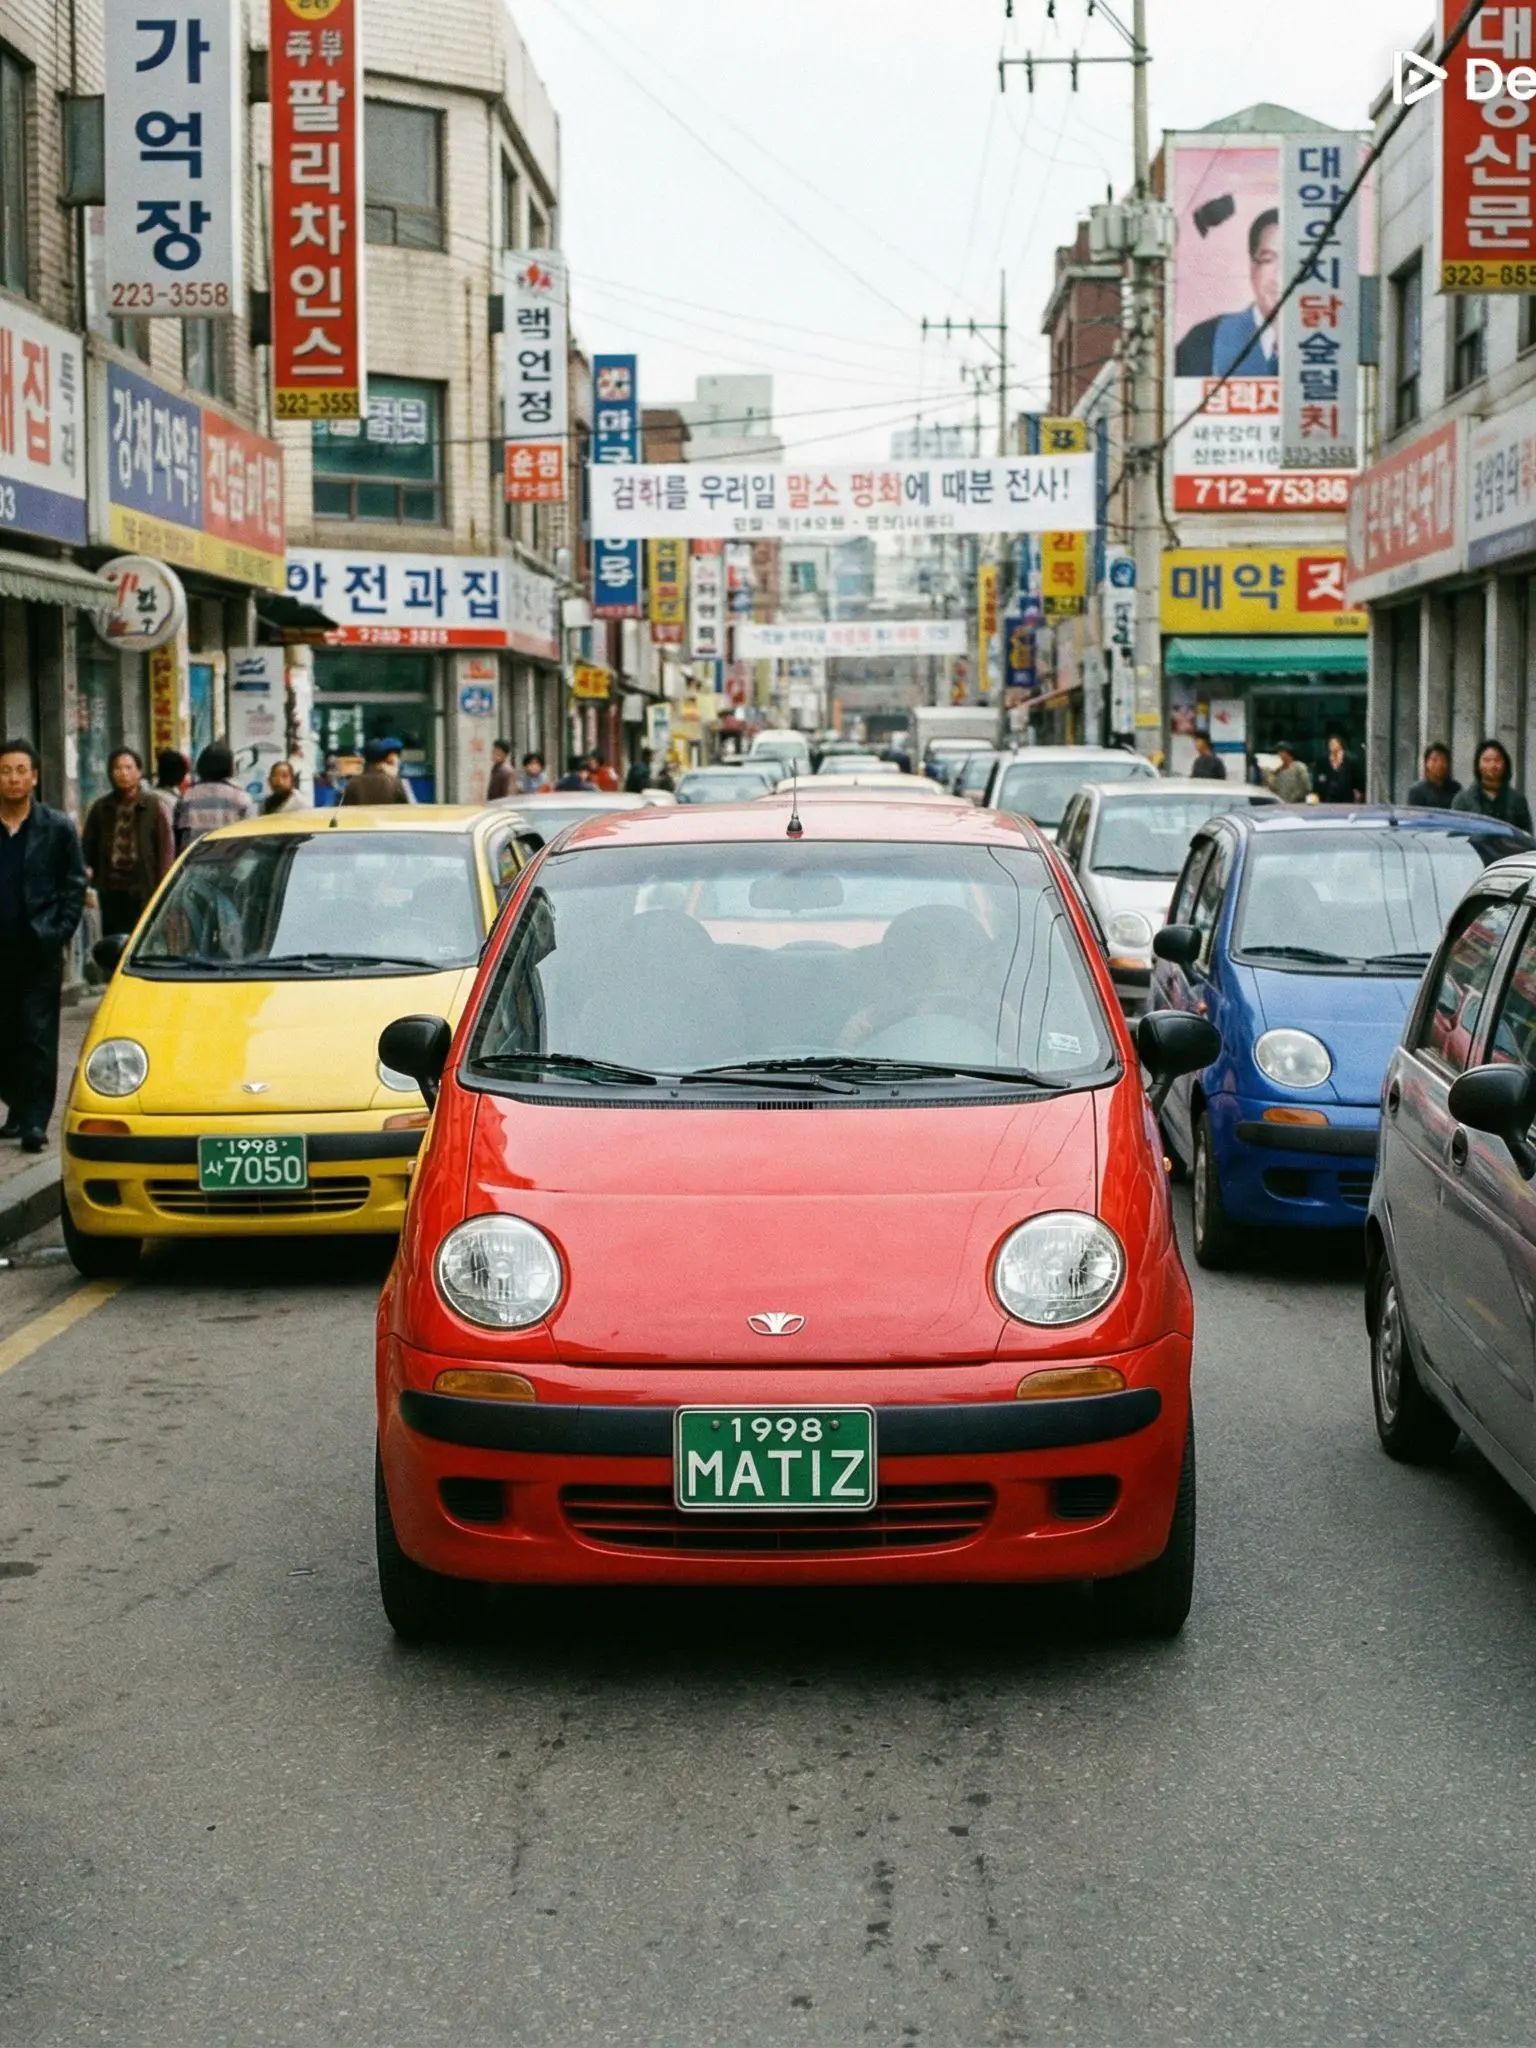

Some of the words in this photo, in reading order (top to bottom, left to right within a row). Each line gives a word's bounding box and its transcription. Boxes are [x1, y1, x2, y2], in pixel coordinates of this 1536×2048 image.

[135, 19, 211, 271] 가억장
[112, 283, 229, 307] 223-3558
[229, 1139, 278, 1155] 1998
[731, 1417, 823, 1443] 1998
[688, 1450, 865, 1497] MATIZ
